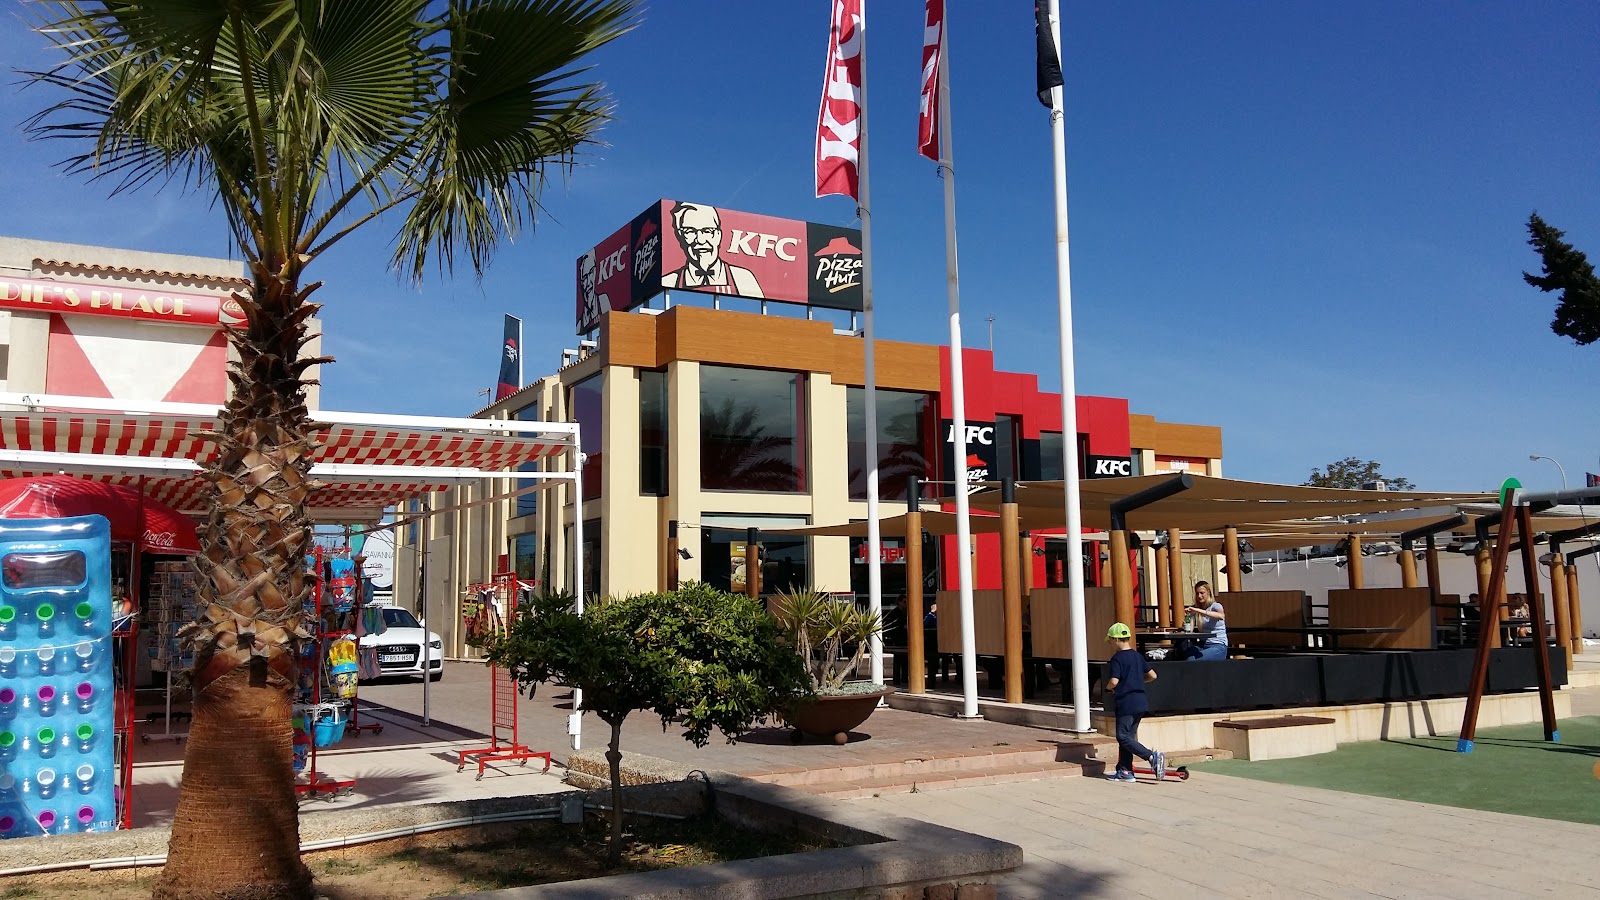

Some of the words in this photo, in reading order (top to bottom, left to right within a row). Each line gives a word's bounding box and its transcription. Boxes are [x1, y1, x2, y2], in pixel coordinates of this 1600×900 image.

[821, 0, 860, 175] KFC
[727, 229, 798, 261] KFC
[598, 244, 627, 285] KFC
[639, 249, 656, 280] Hut
[824, 271, 859, 288] Hut
[91, 291, 192, 316] PLACE
[1095, 460, 1130, 475] KFC
